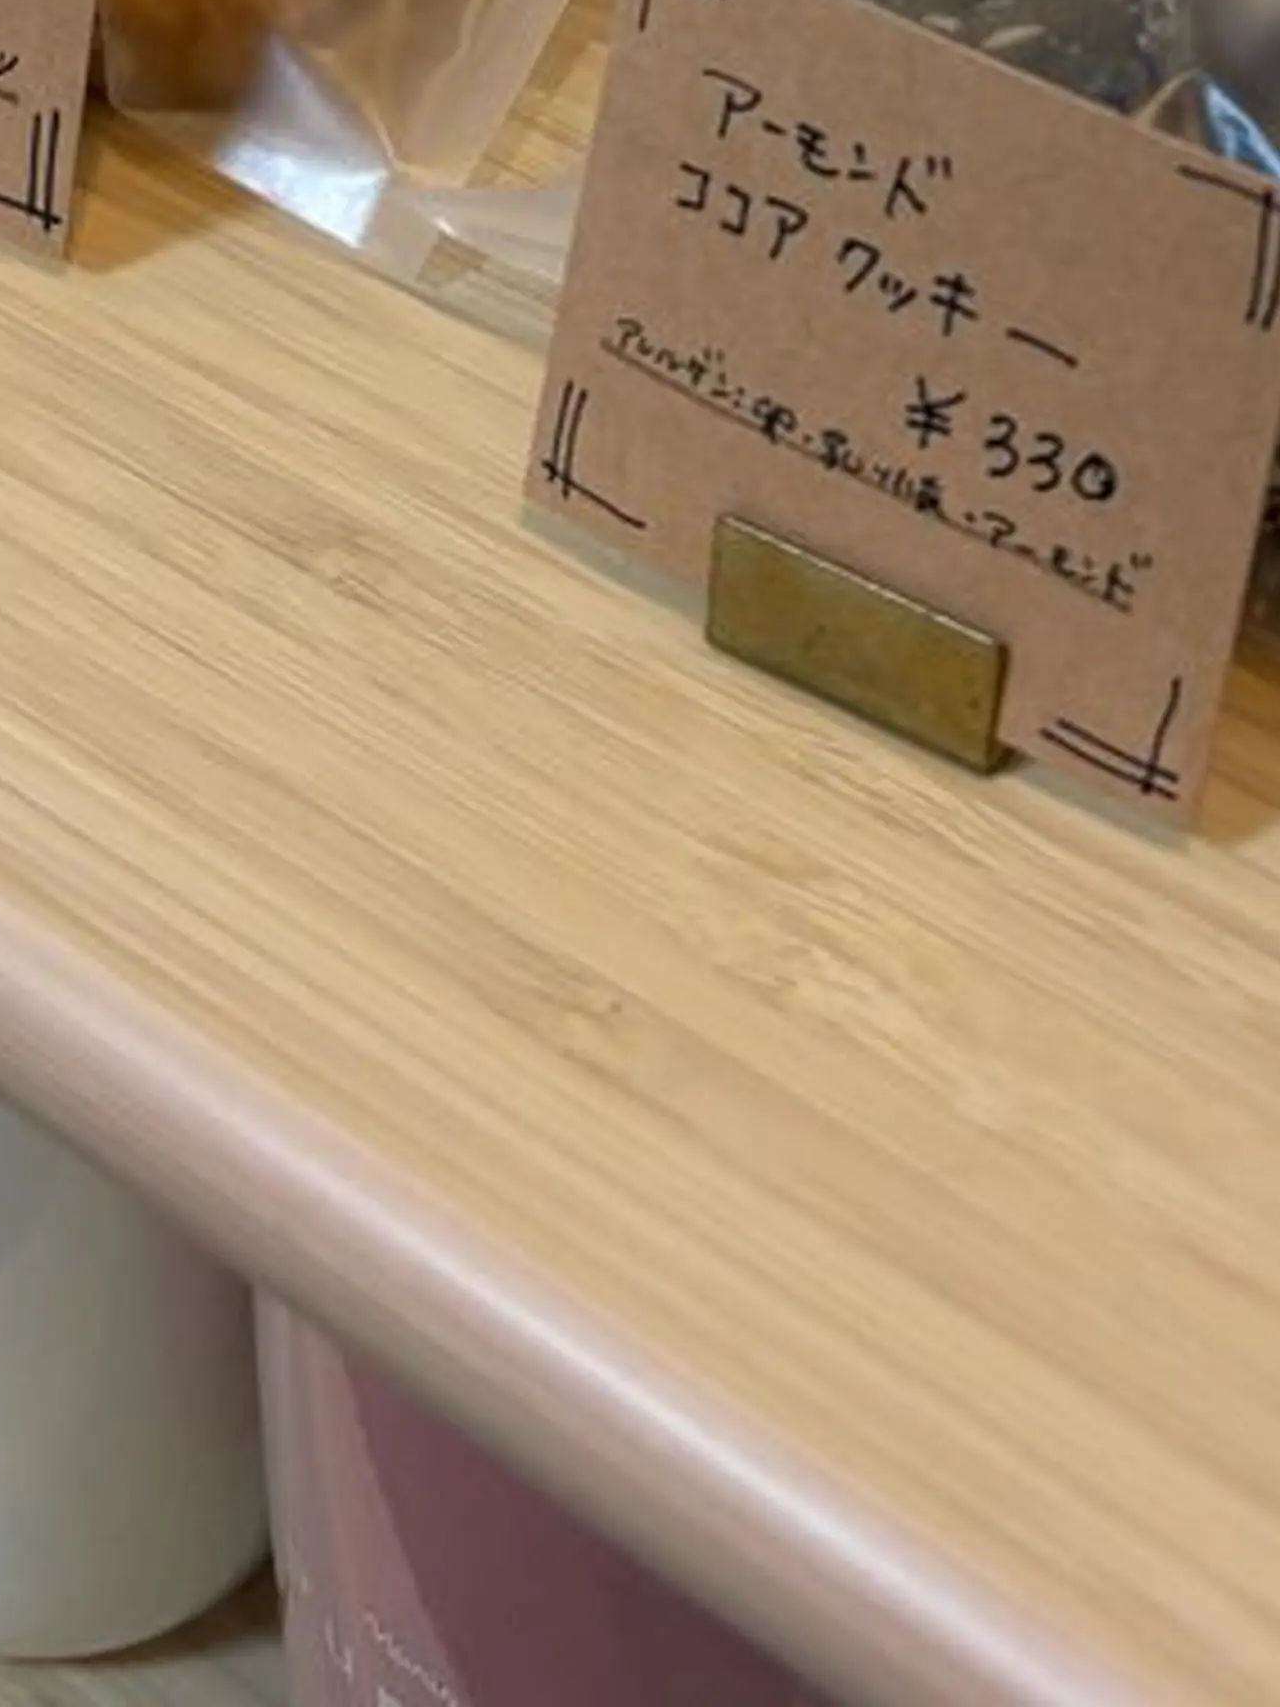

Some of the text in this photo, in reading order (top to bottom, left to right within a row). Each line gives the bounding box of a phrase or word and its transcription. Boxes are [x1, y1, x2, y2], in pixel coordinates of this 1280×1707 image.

[701, 68, 954, 220] アーモンド
[676, 160, 1081, 368] ココア クッキー
[904, 373, 1119, 502] ¥330
